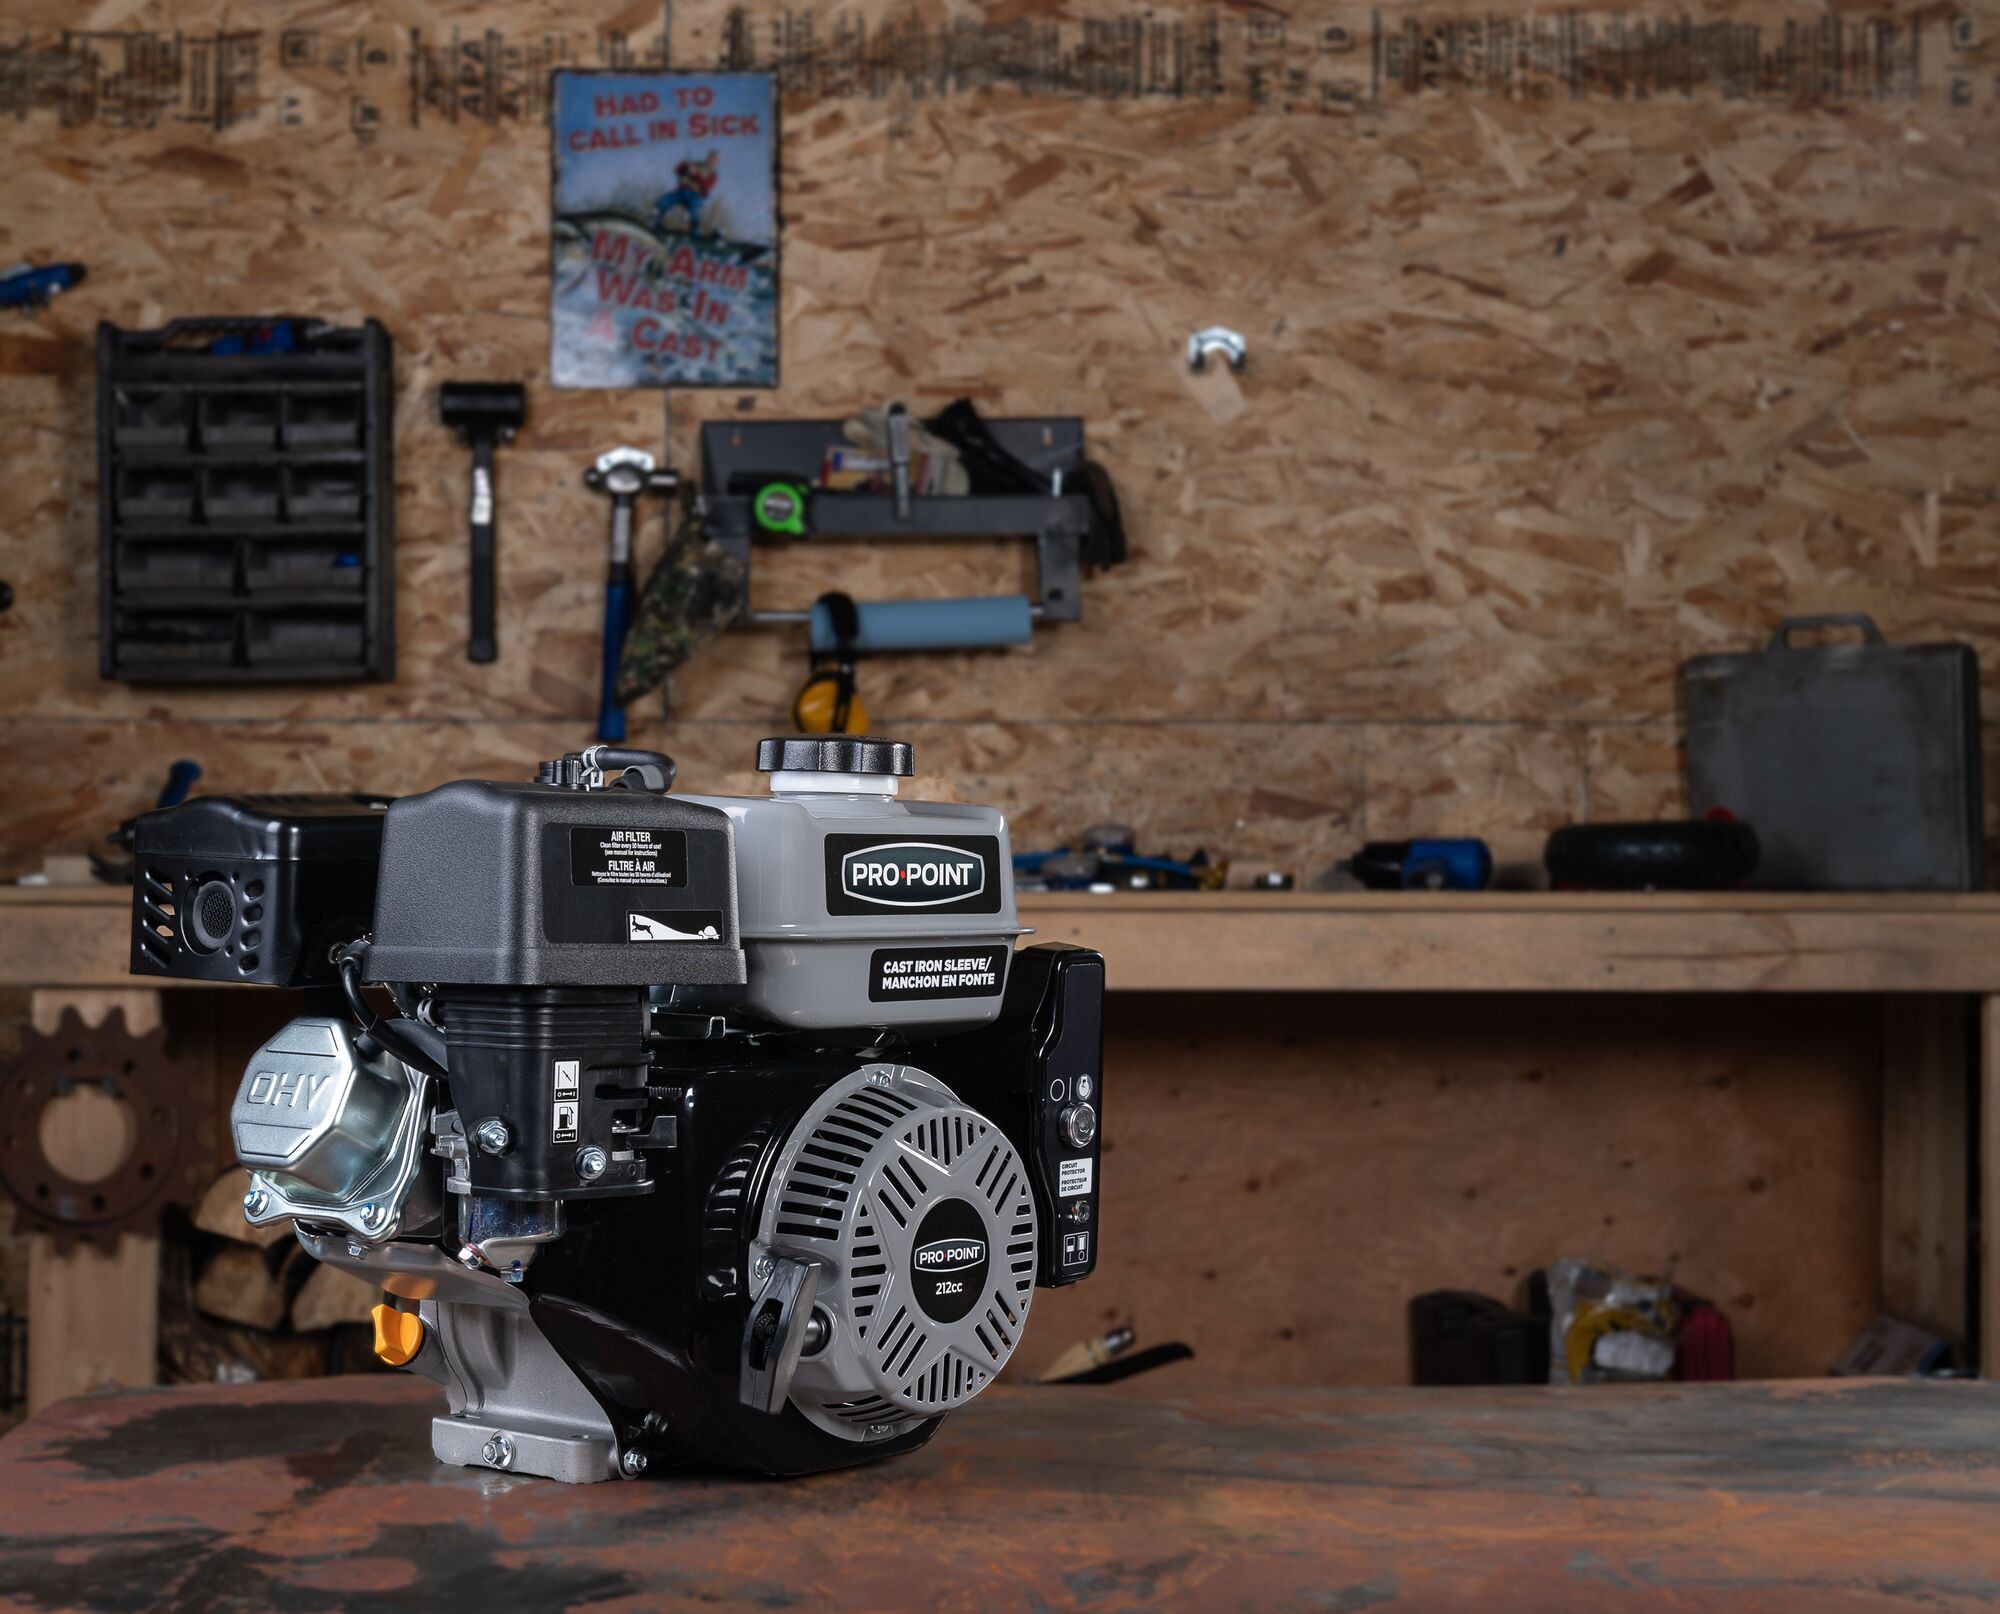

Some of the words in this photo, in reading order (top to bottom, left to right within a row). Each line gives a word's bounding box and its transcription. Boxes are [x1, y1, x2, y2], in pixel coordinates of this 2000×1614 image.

[593, 91, 659, 118] HAD
[673, 86, 715, 110] TO
[568, 127, 643, 150] CALL
[648, 120, 678, 140] IN
[586, 309, 615, 341] A
[611, 830, 624, 842] AIR
[625, 831, 651, 843] FILTER
[608, 860, 634, 871] FILTRE
[635, 858, 641, 871] À
[642, 861, 656, 871] AIR
[906, 863, 974, 886] POINT
[883, 961, 914, 974] CAST
[915, 959, 943, 973] IRON
[944, 956, 992, 972] SLEEVE/
[882, 976, 940, 990] MANCHON
[941, 975, 957, 988] EN
[958, 973, 996, 986] FONTE
[1061, 1168, 1086, 1176] PROTECTOR
[1061, 1177, 1088, 1185] PROTECTEUR
[946, 1246, 980, 1262] POINT
[935, 1281, 963, 1295] 212cc
